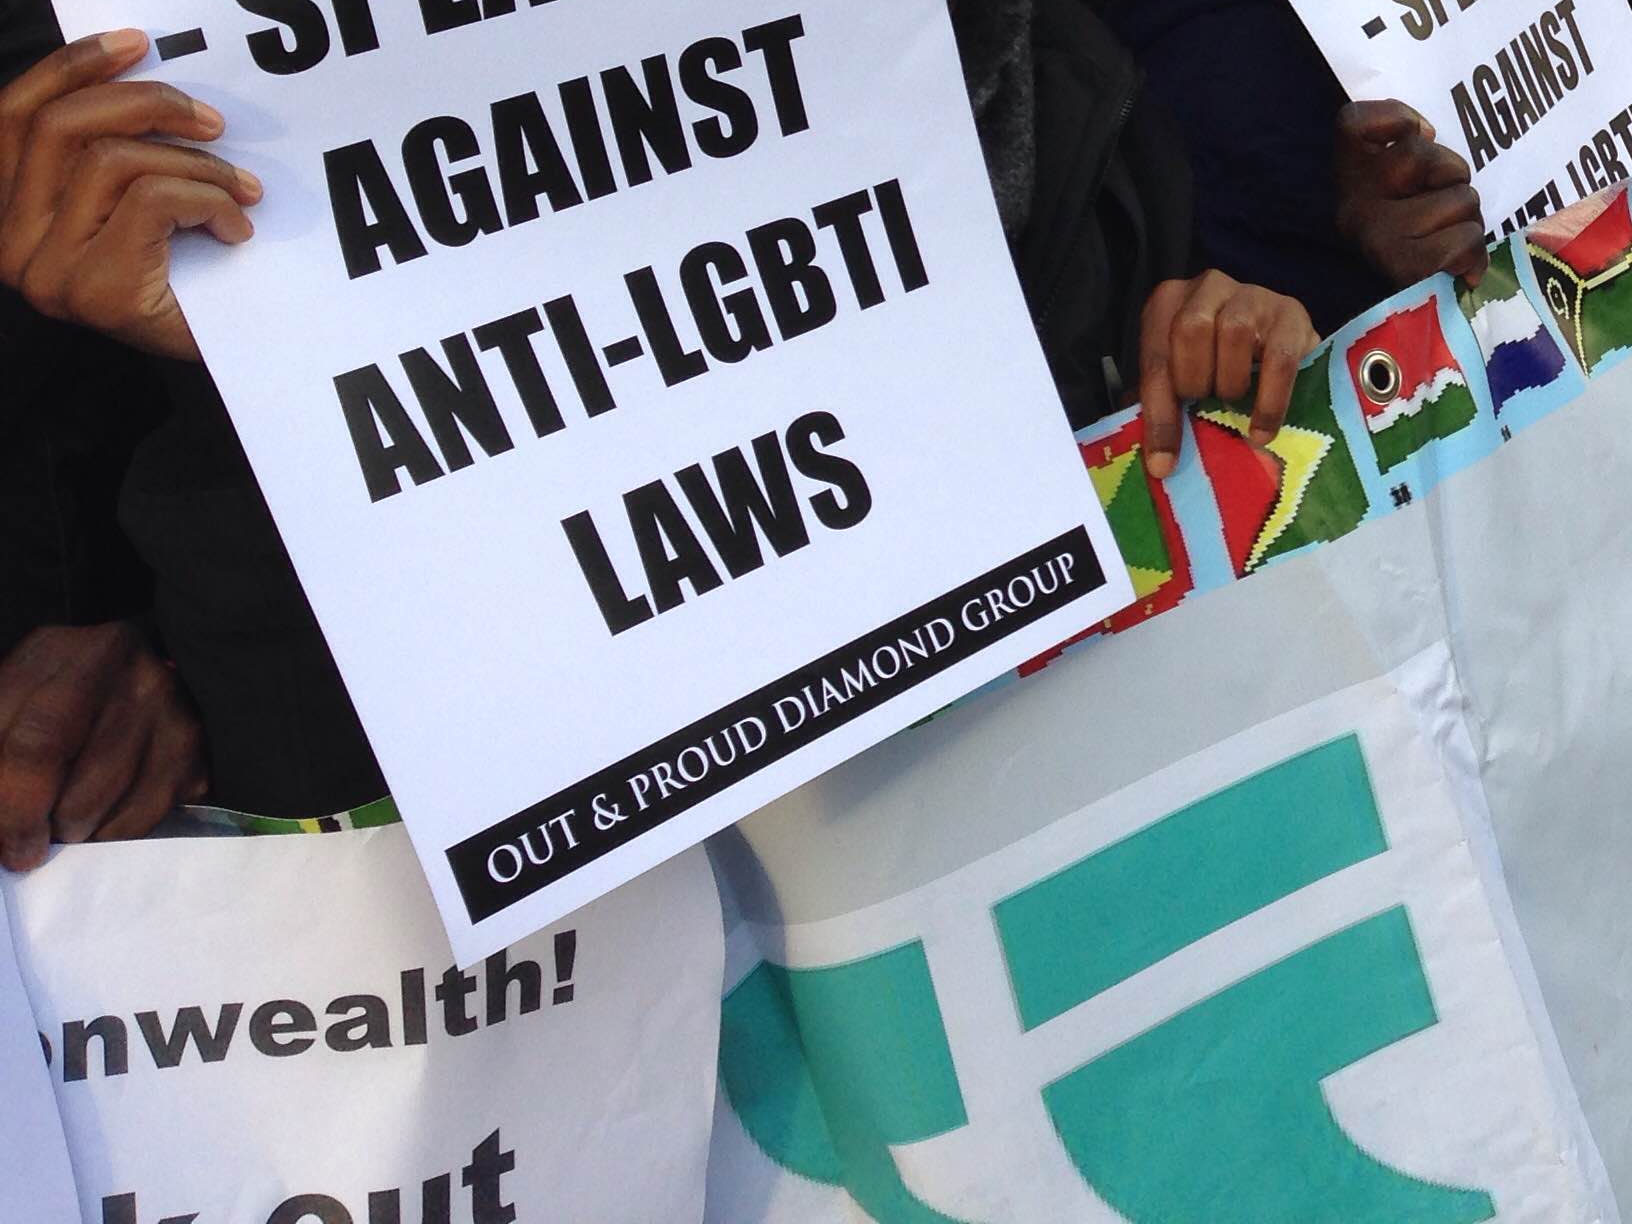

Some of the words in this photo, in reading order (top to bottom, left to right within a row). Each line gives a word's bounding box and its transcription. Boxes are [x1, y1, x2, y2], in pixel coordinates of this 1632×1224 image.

[323, 14, 812, 279] AGAINST
[333, 178, 930, 503] ANTI-LGBTI
[561, 410, 873, 636] LAWS
[486, 810, 580, 884] OUT
[592, 792, 627, 831] &
[629, 716, 768, 816] PROUD
[772, 617, 956, 732] DIAMOND
[962, 551, 1076, 633] GROUP
[39, 929, 577, 1083] nwealth!
